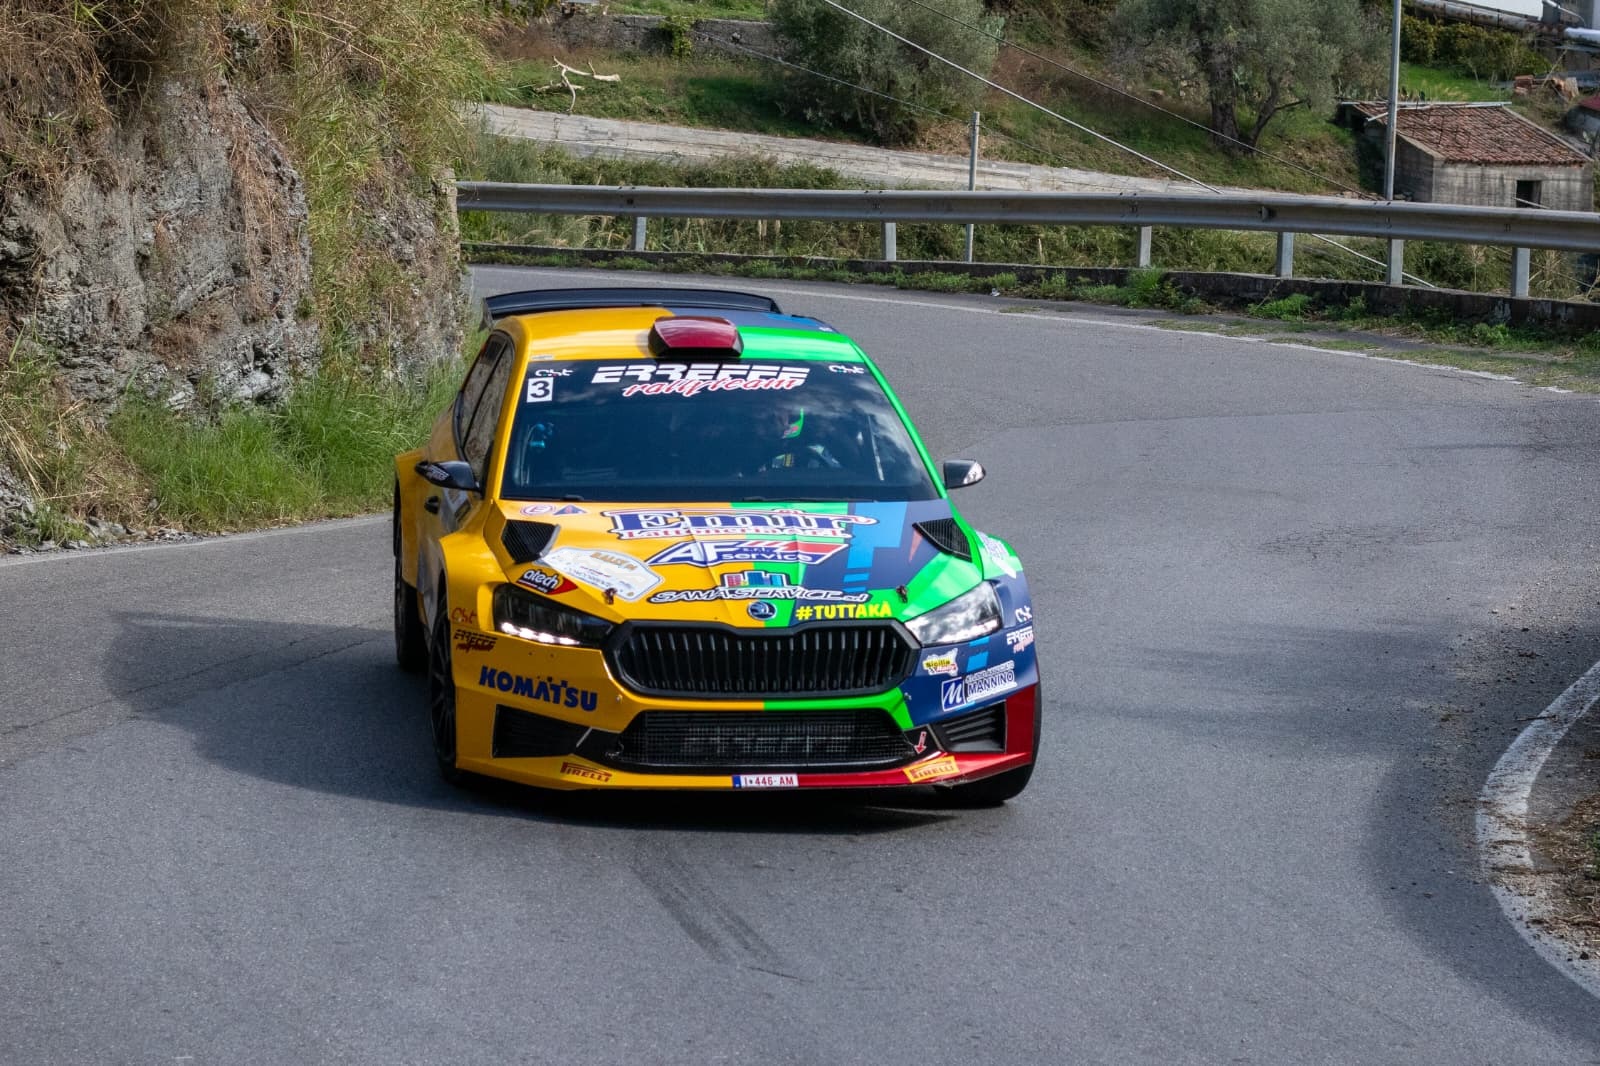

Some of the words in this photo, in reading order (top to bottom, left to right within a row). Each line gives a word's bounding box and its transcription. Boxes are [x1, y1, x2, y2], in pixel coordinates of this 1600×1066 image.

[591, 363, 810, 387] ERREFFE
[529, 380, 551, 399] 3
[721, 552, 813, 562] service
[478, 665, 598, 712] KOMATSU
[968, 671, 1014, 696] MANNINO
[560, 761, 613, 783] PIRELLI
[908, 759, 955, 780] PIRELLI
